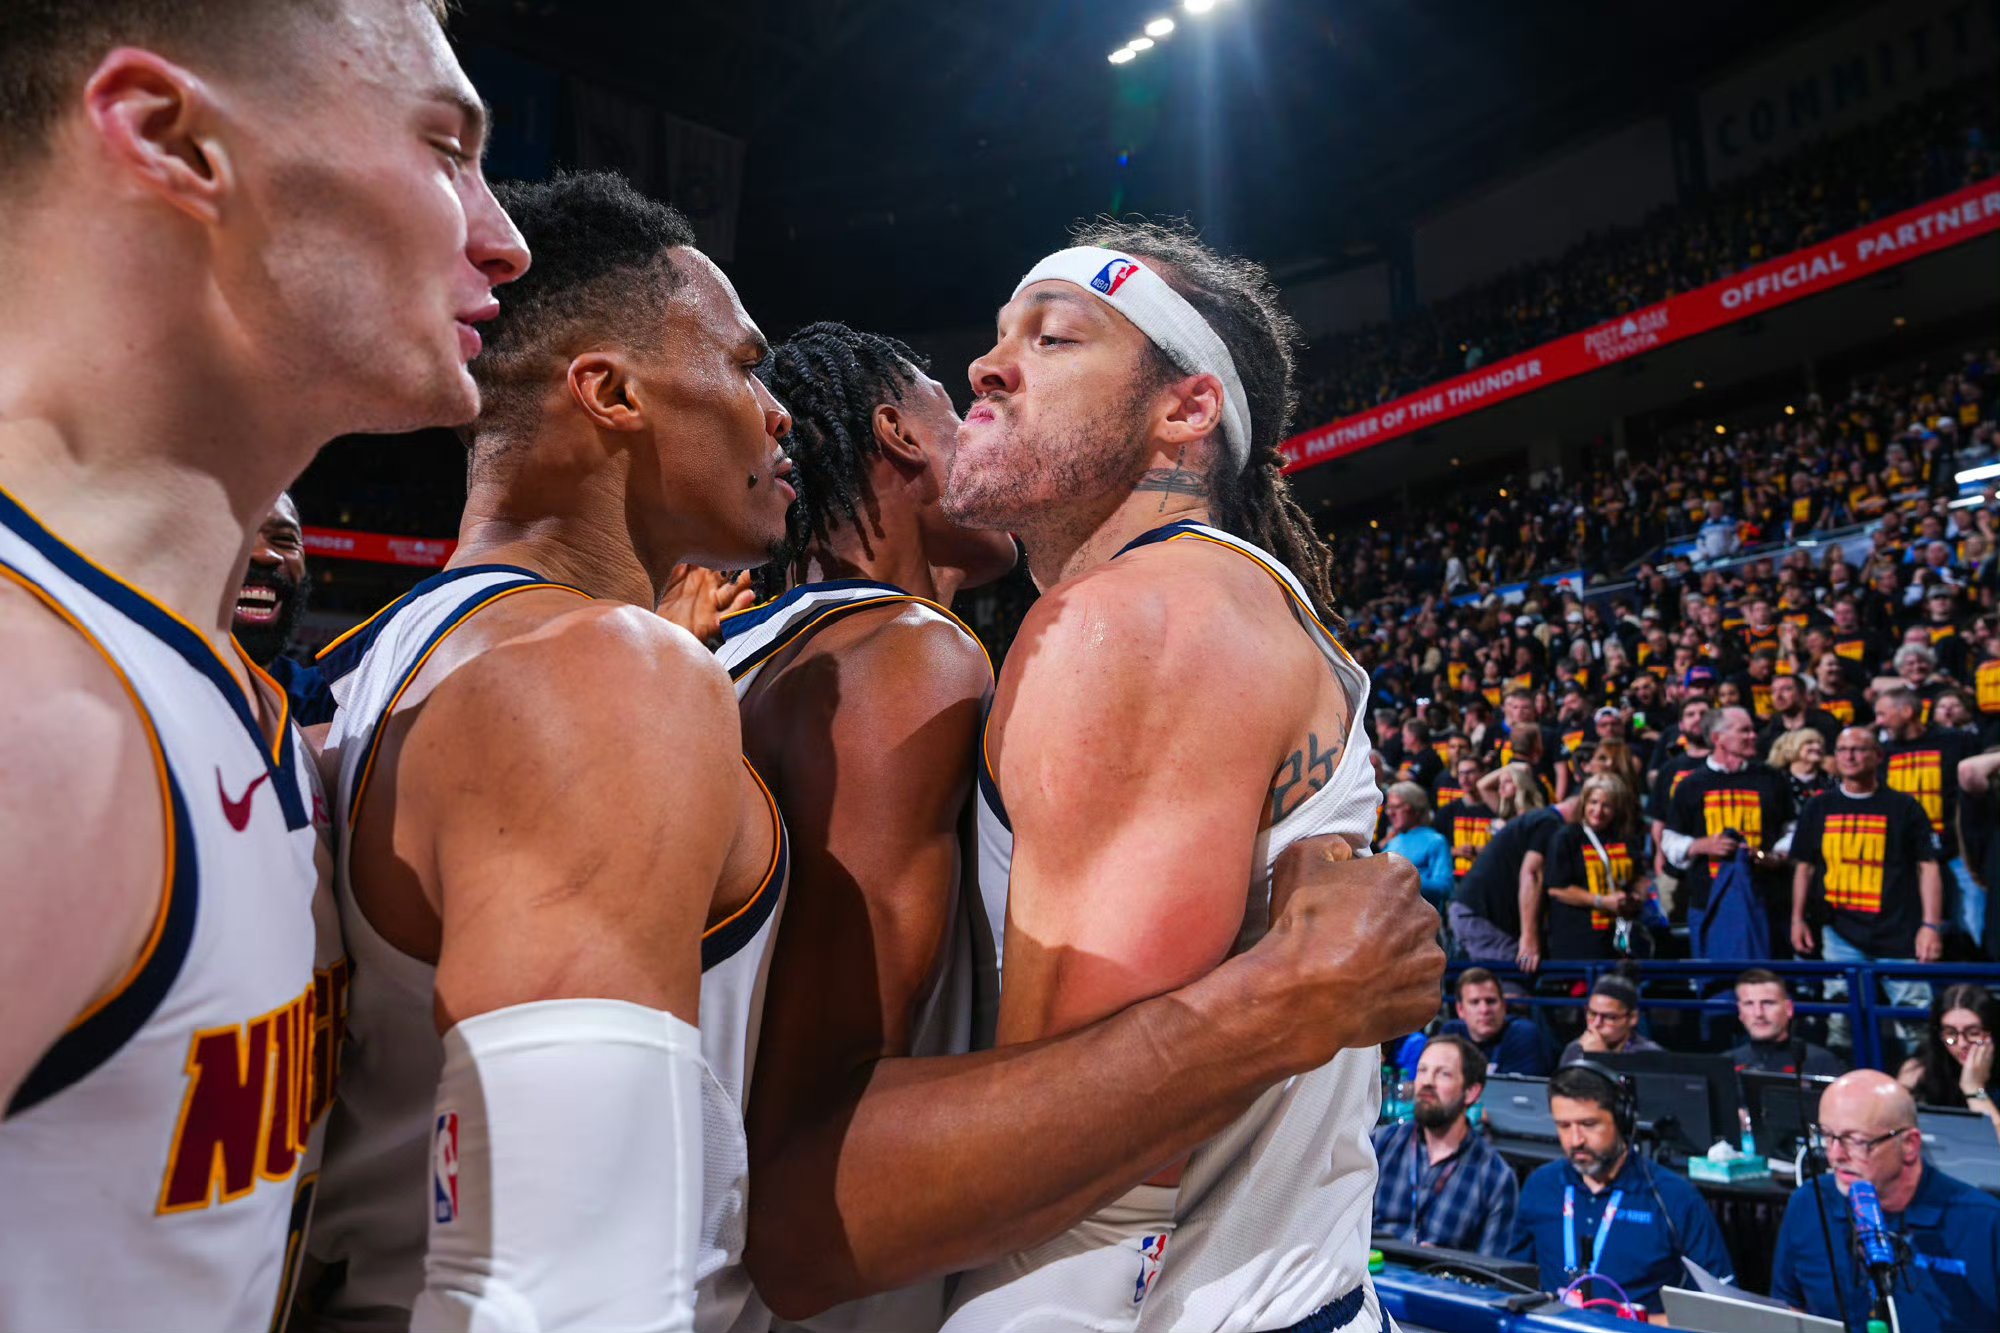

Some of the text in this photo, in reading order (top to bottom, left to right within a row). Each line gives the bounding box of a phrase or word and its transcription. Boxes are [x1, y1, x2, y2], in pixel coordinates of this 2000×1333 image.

[1092, 277, 1109, 291] NBA
[1720, 189, 2000, 309] OFFICIAL PARTNER
[1305, 416, 1379, 458] PARTNER
[1381, 407, 1407, 431] OF
[1410, 394, 1444, 422] THE
[1448, 358, 1543, 407] THUNDER
